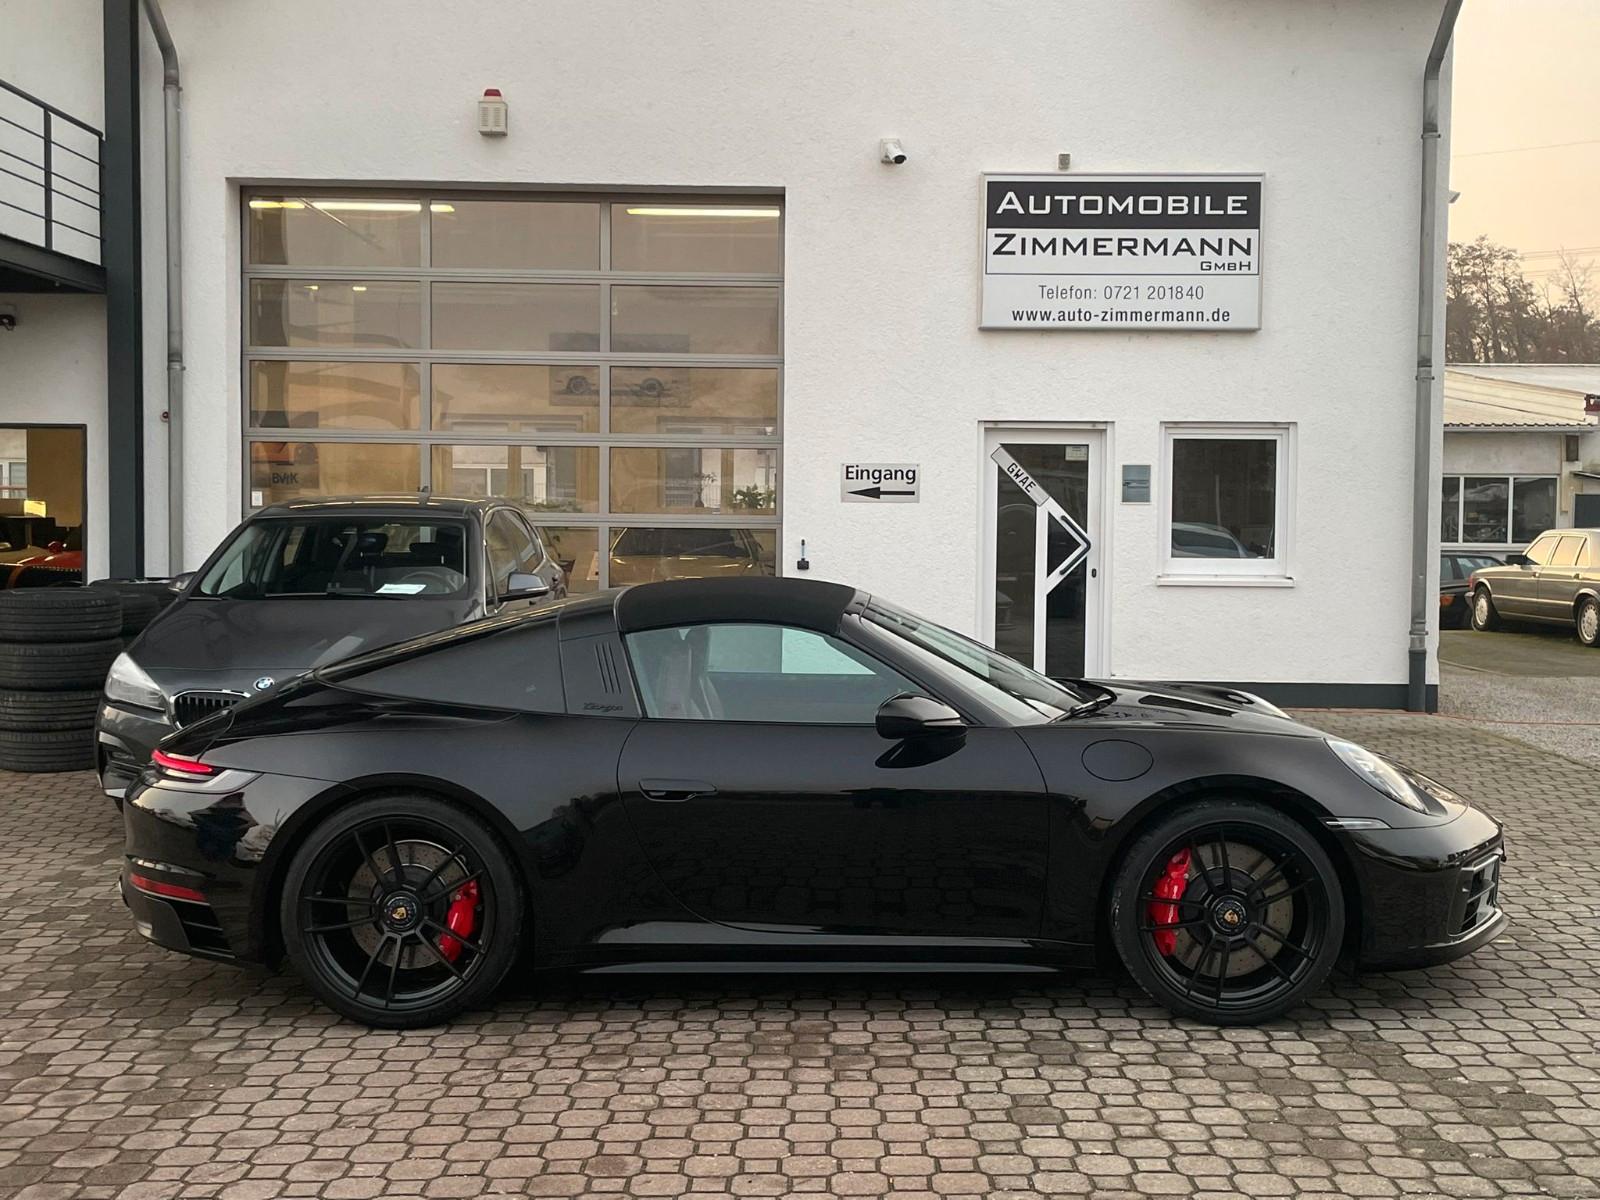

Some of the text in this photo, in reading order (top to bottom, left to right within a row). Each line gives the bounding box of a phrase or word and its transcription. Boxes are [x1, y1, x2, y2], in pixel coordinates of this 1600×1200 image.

[996, 191, 1248, 215] AUTOMOBILE
[992, 233, 1251, 256] ZIMMERMANN
[1038, 284, 1205, 300] Telefon: 0721 201840
[1012, 307, 1231, 322] www.auto-zimmermann.de
[845, 465, 917, 484] Eingang
[1006, 462, 1037, 494] GWAE
